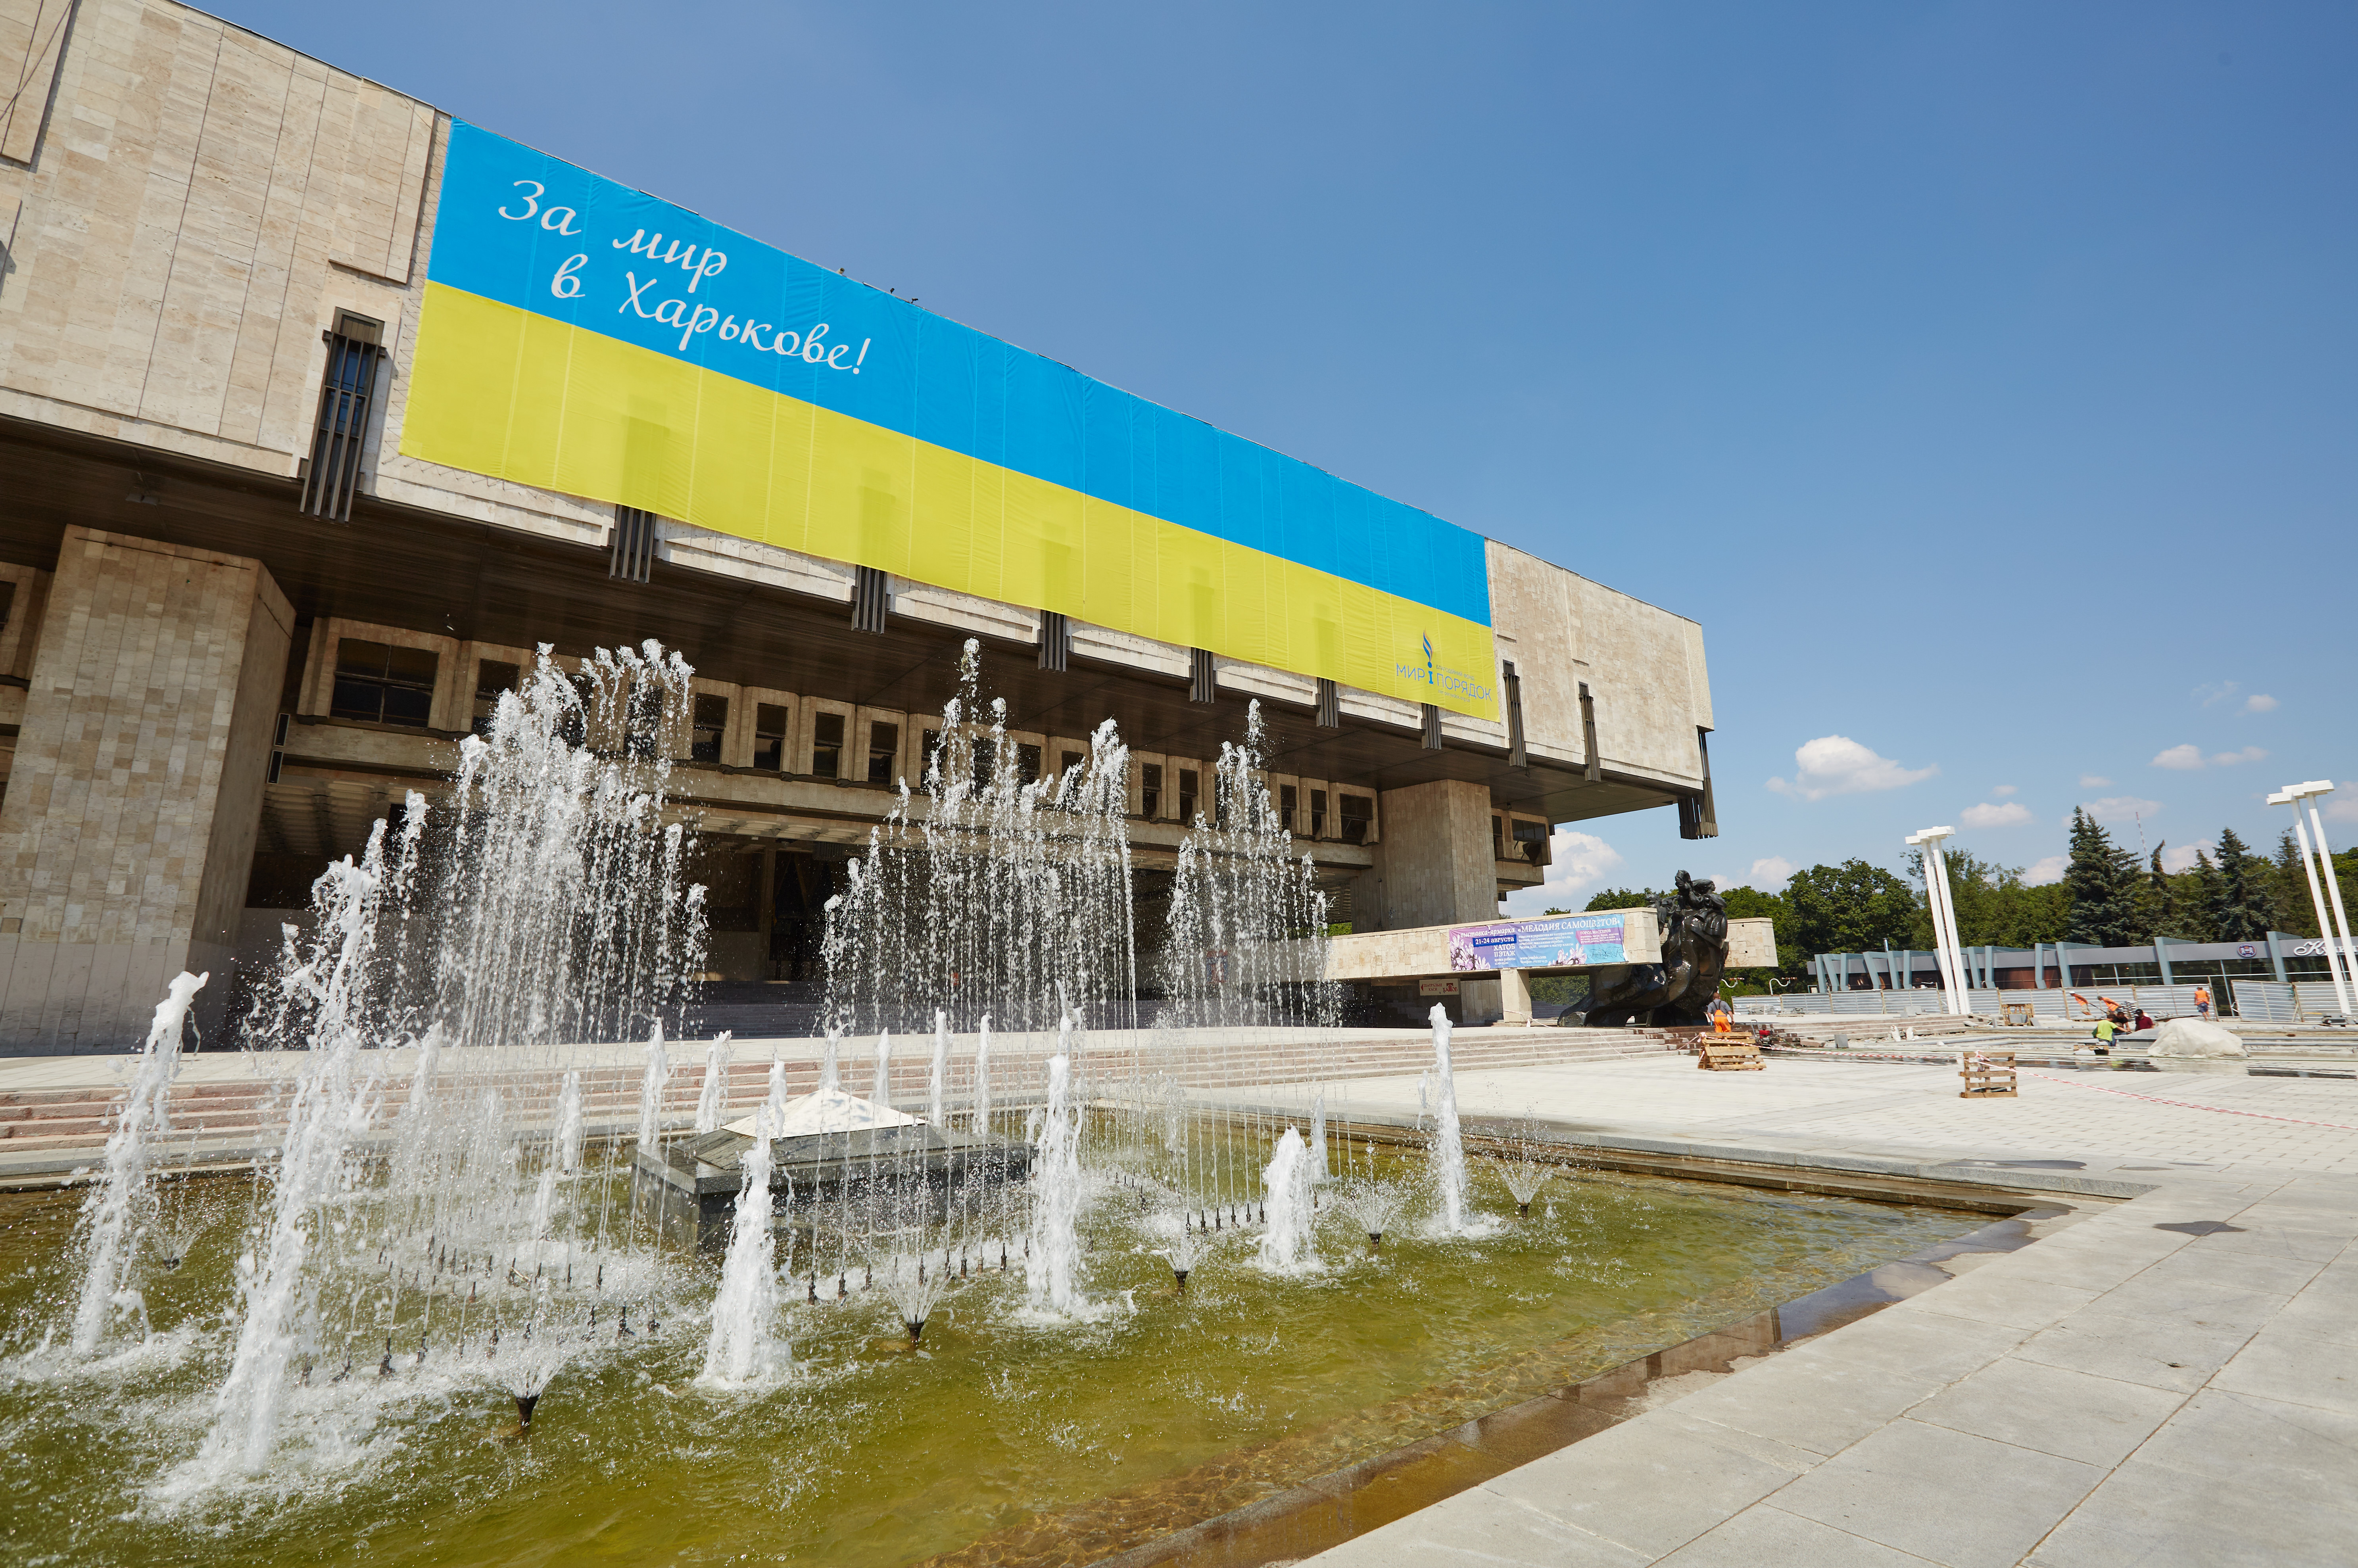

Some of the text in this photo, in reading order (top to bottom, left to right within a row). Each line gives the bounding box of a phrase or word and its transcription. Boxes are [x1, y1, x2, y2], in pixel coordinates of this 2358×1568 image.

[499, 180, 727, 293] За мир
[551, 253, 871, 374] в Харькове!
[1396, 662, 1425, 681] МИР
[1437, 673, 1492, 701] ПОРЯДОК
[1460, 928, 1515, 937] выставка-ярмарка
[1518, 923, 1560, 933] «МЕЛОДИЯ
